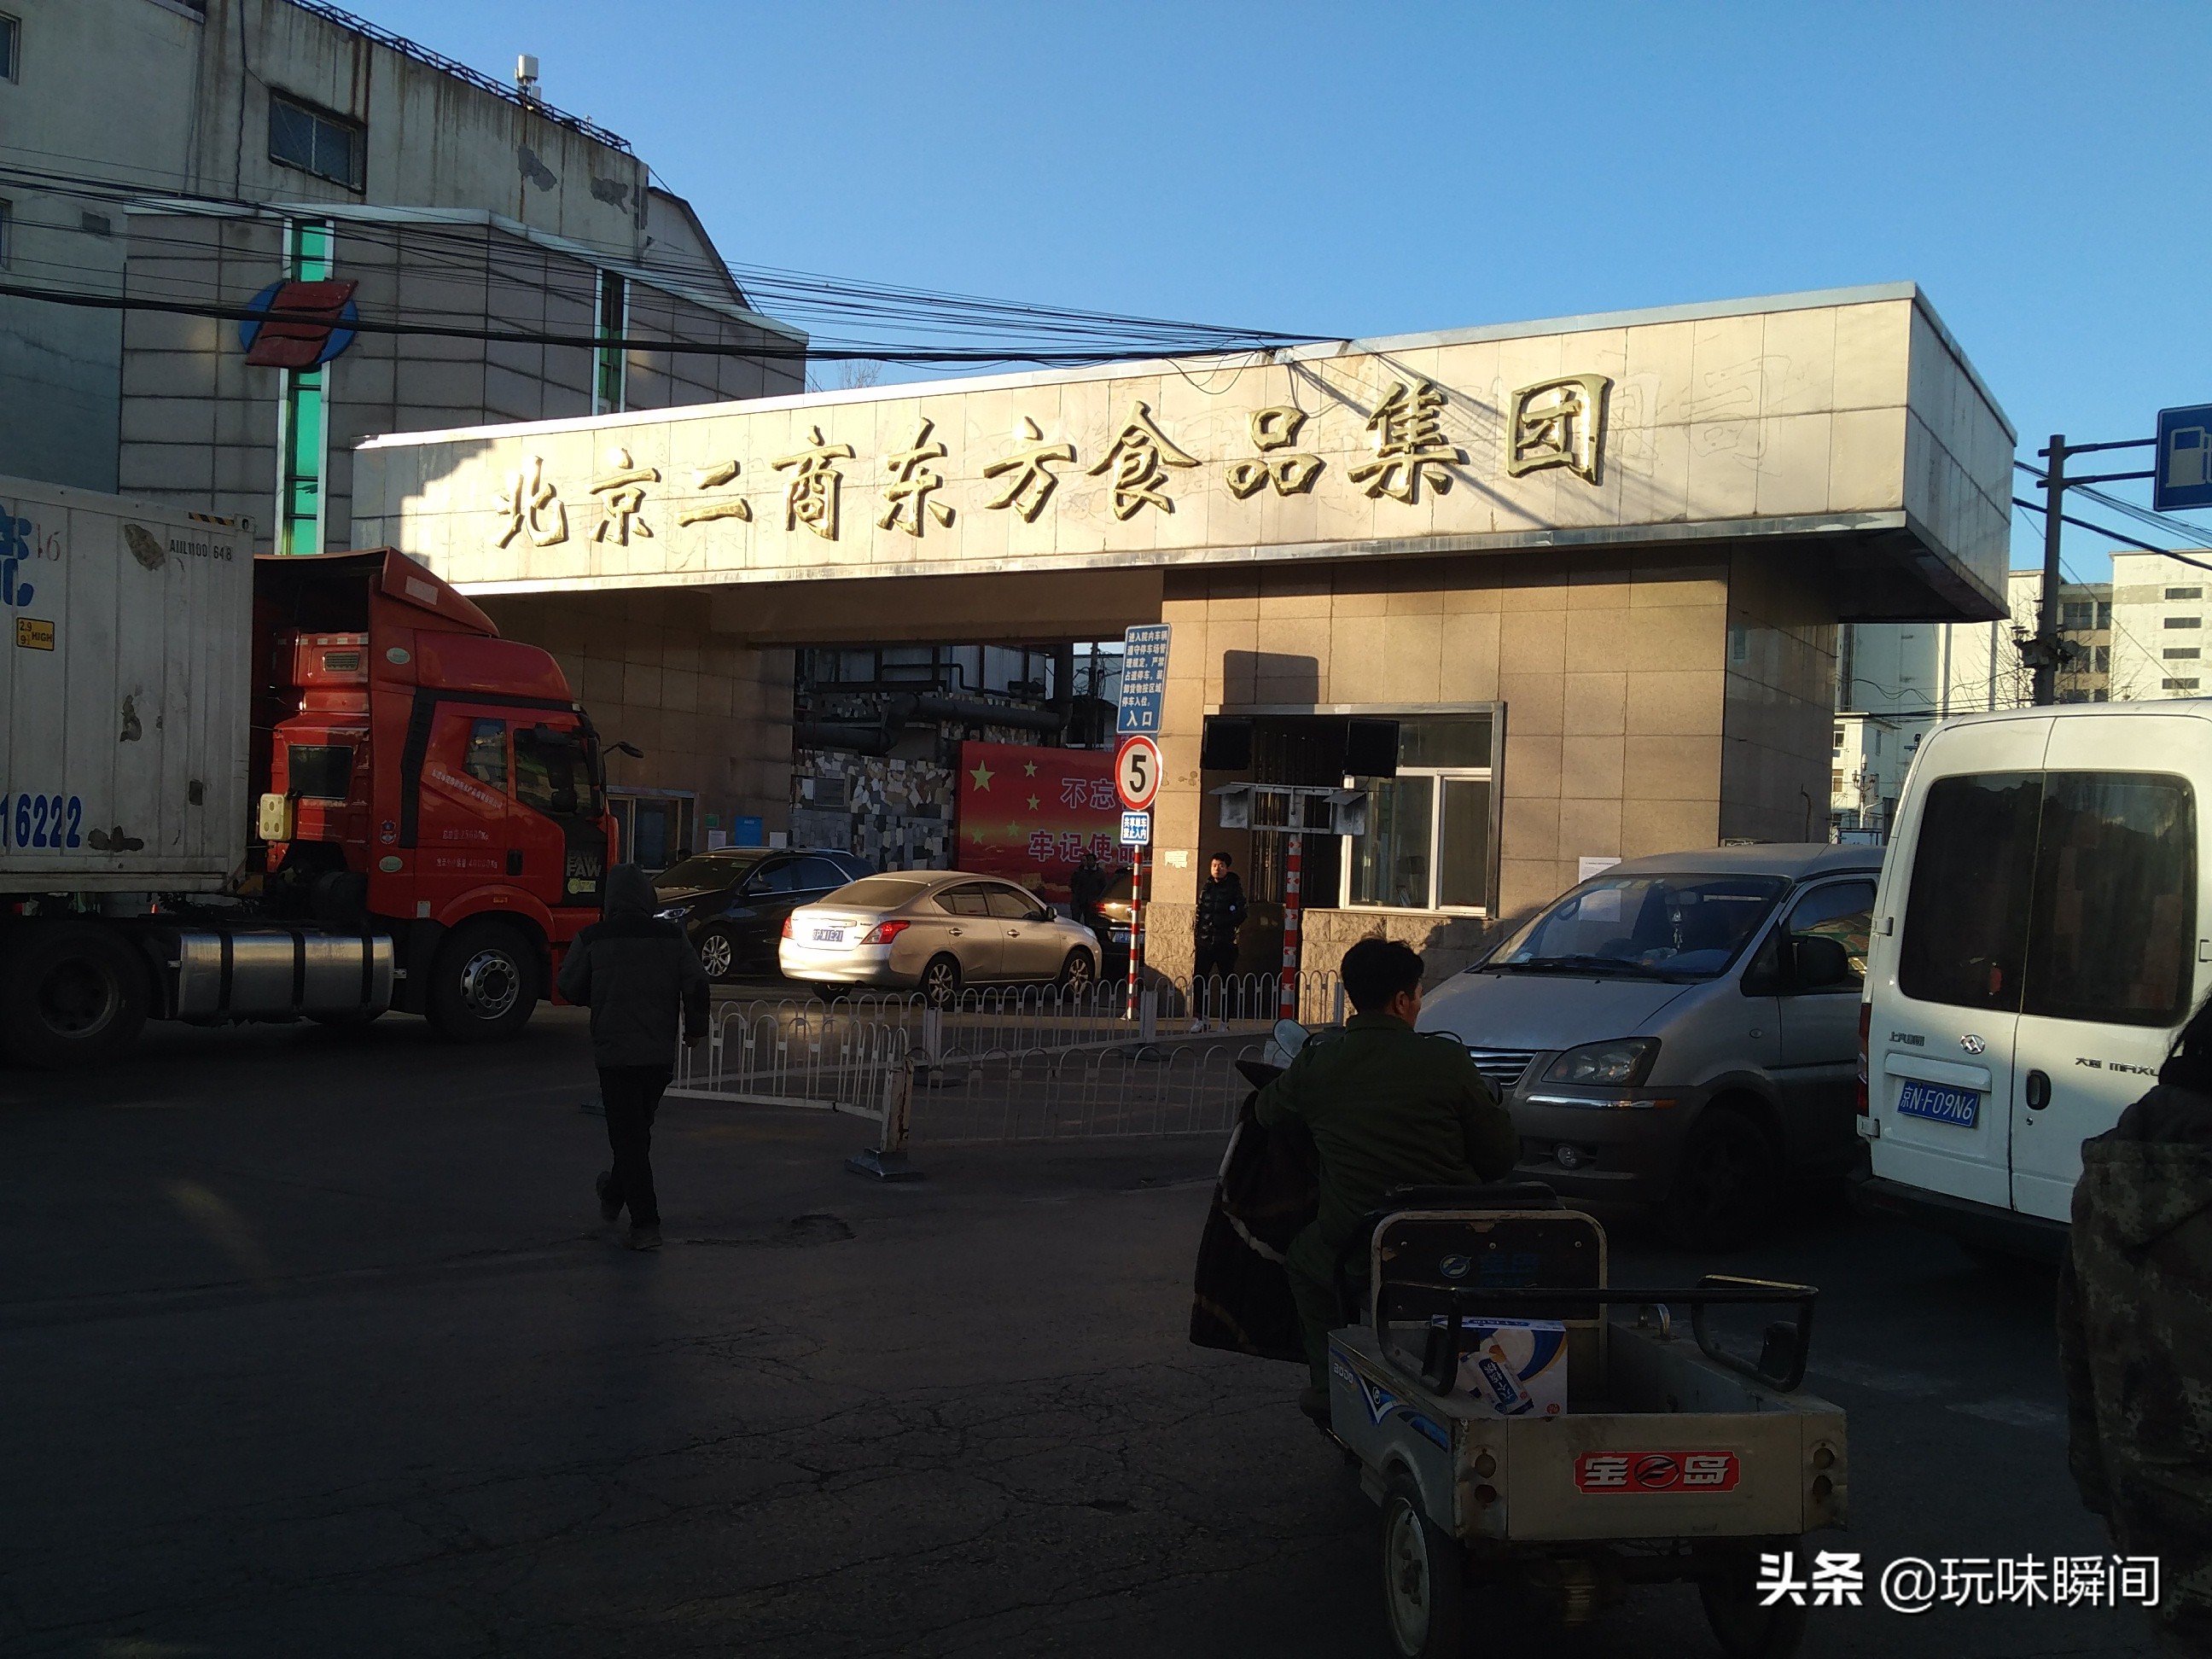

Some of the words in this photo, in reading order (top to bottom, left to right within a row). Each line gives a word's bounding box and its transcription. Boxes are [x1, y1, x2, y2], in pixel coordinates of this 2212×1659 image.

[493, 373, 1613, 548] 北京二商东方食品集团
[32, 632, 53, 643] HIGH
[1128, 630, 1167, 643] 进入院内车辆
[1126, 643, 1167, 655] 遵守停车场管
[1123, 683, 1161, 695] 卸货物按区域
[1126, 710, 1153, 727] 入口
[1129, 754, 1147, 794] 5
[1060, 777, 1126, 810] 不忘
[1124, 817, 1147, 828] 共享单车
[1123, 828, 1147, 840] 禁止入内
[2109, 1061, 2160, 1077] MAXU
[1582, 1454, 1730, 1489] 宝岛
